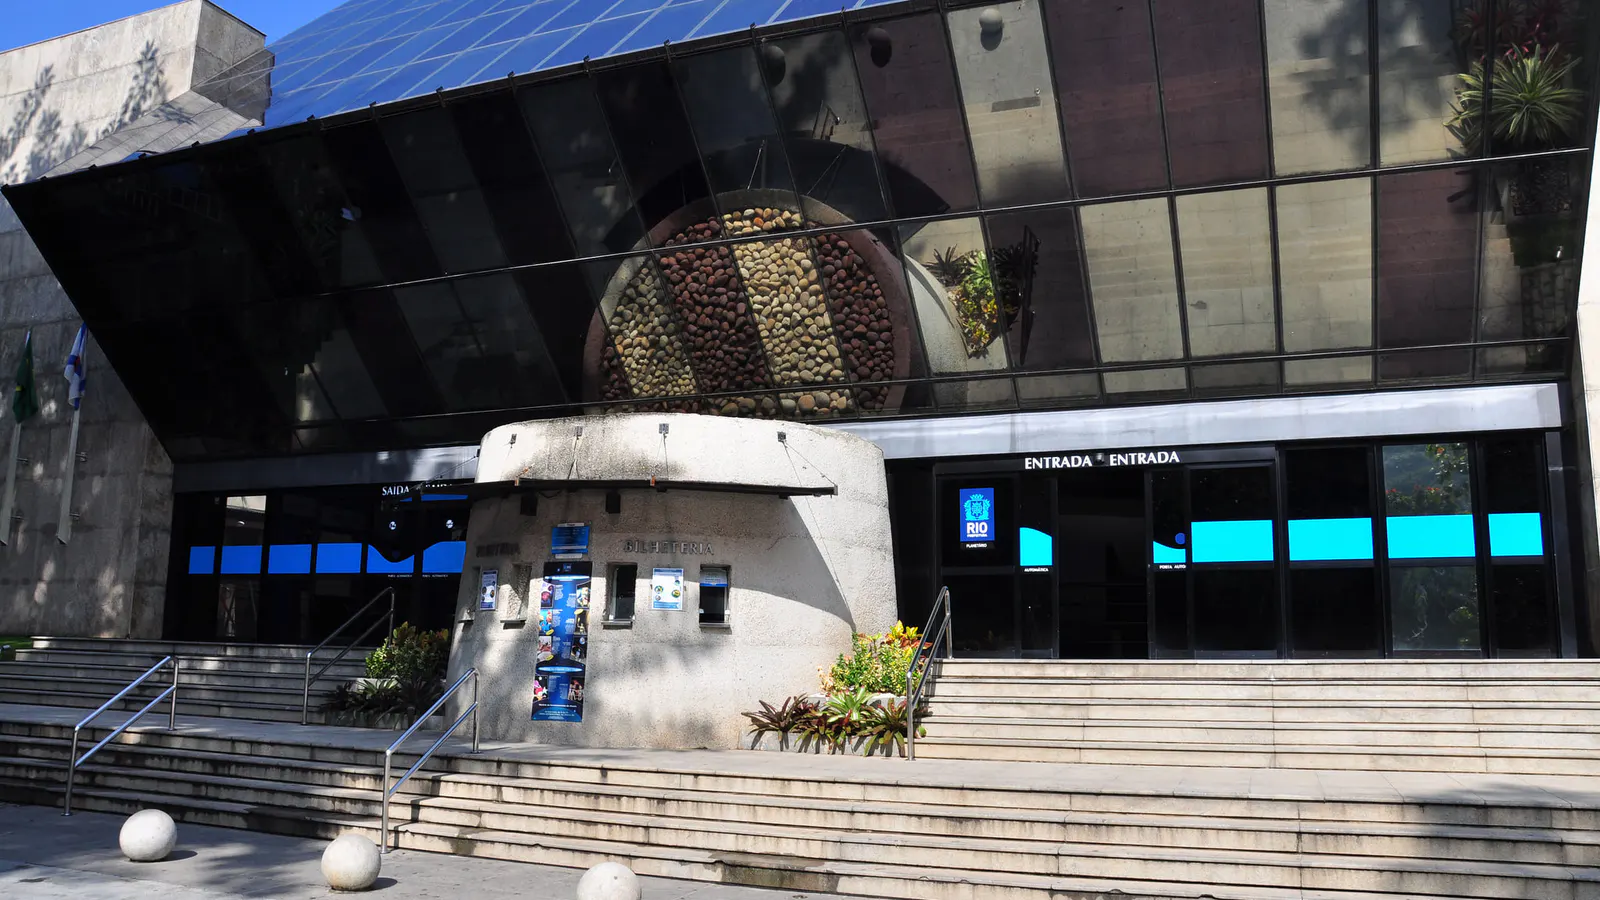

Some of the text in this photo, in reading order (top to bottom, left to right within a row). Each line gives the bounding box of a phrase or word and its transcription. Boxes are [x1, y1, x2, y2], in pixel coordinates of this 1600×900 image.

[1024, 450, 1180, 470] ENTRADA ENTRADA
[966, 522, 988, 534] RIO
[623, 540, 715, 556] BILHETERIA
